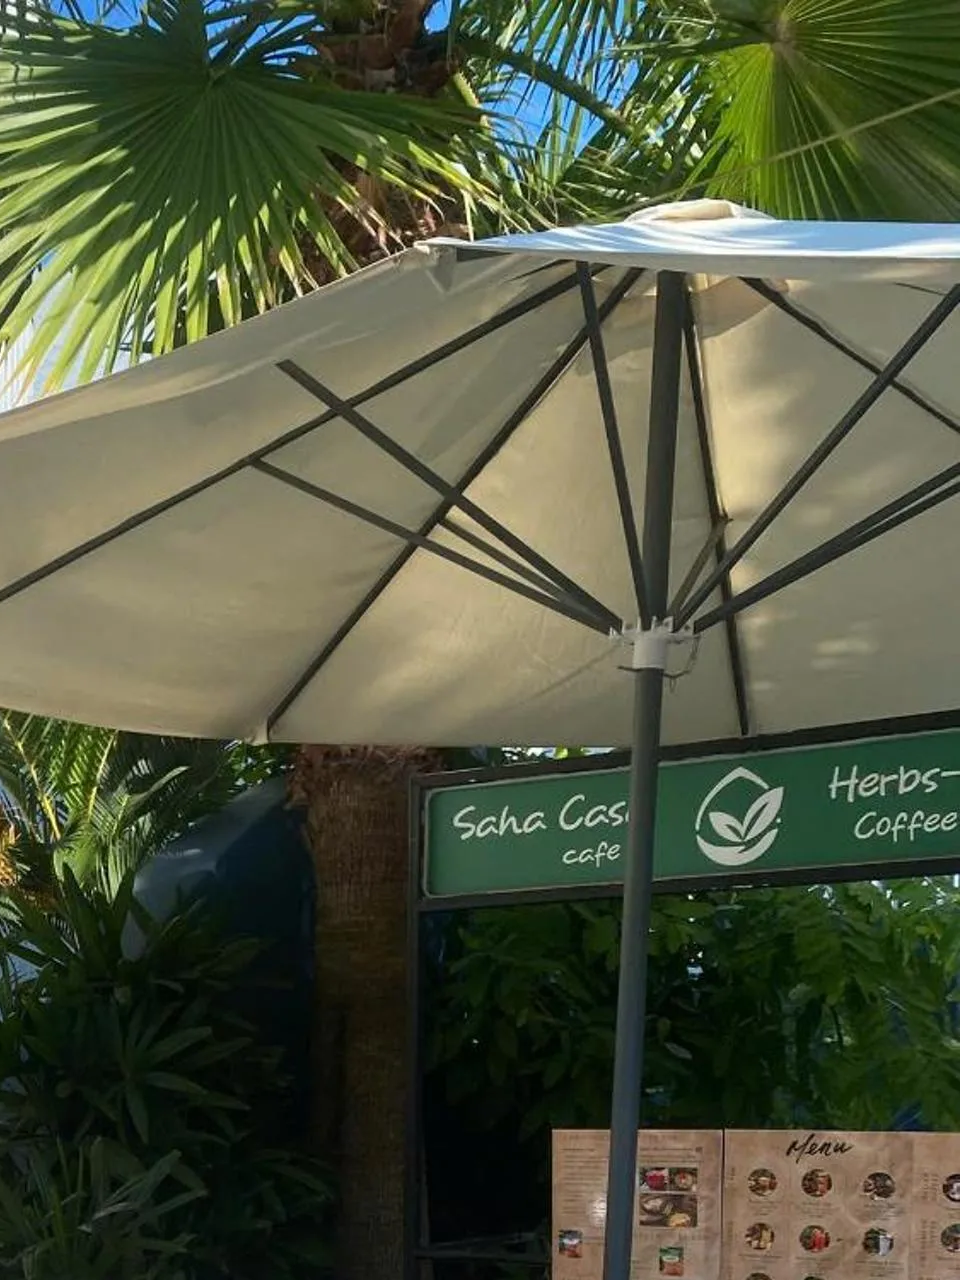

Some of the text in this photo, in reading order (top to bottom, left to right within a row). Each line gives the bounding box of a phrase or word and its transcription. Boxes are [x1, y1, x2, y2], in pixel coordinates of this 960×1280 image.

[452, 793, 631, 841] Saha Cas
[853, 810, 959, 843] Coffee
[562, 840, 622, 869] cafe
[785, 1132, 855, 1165] Menu
